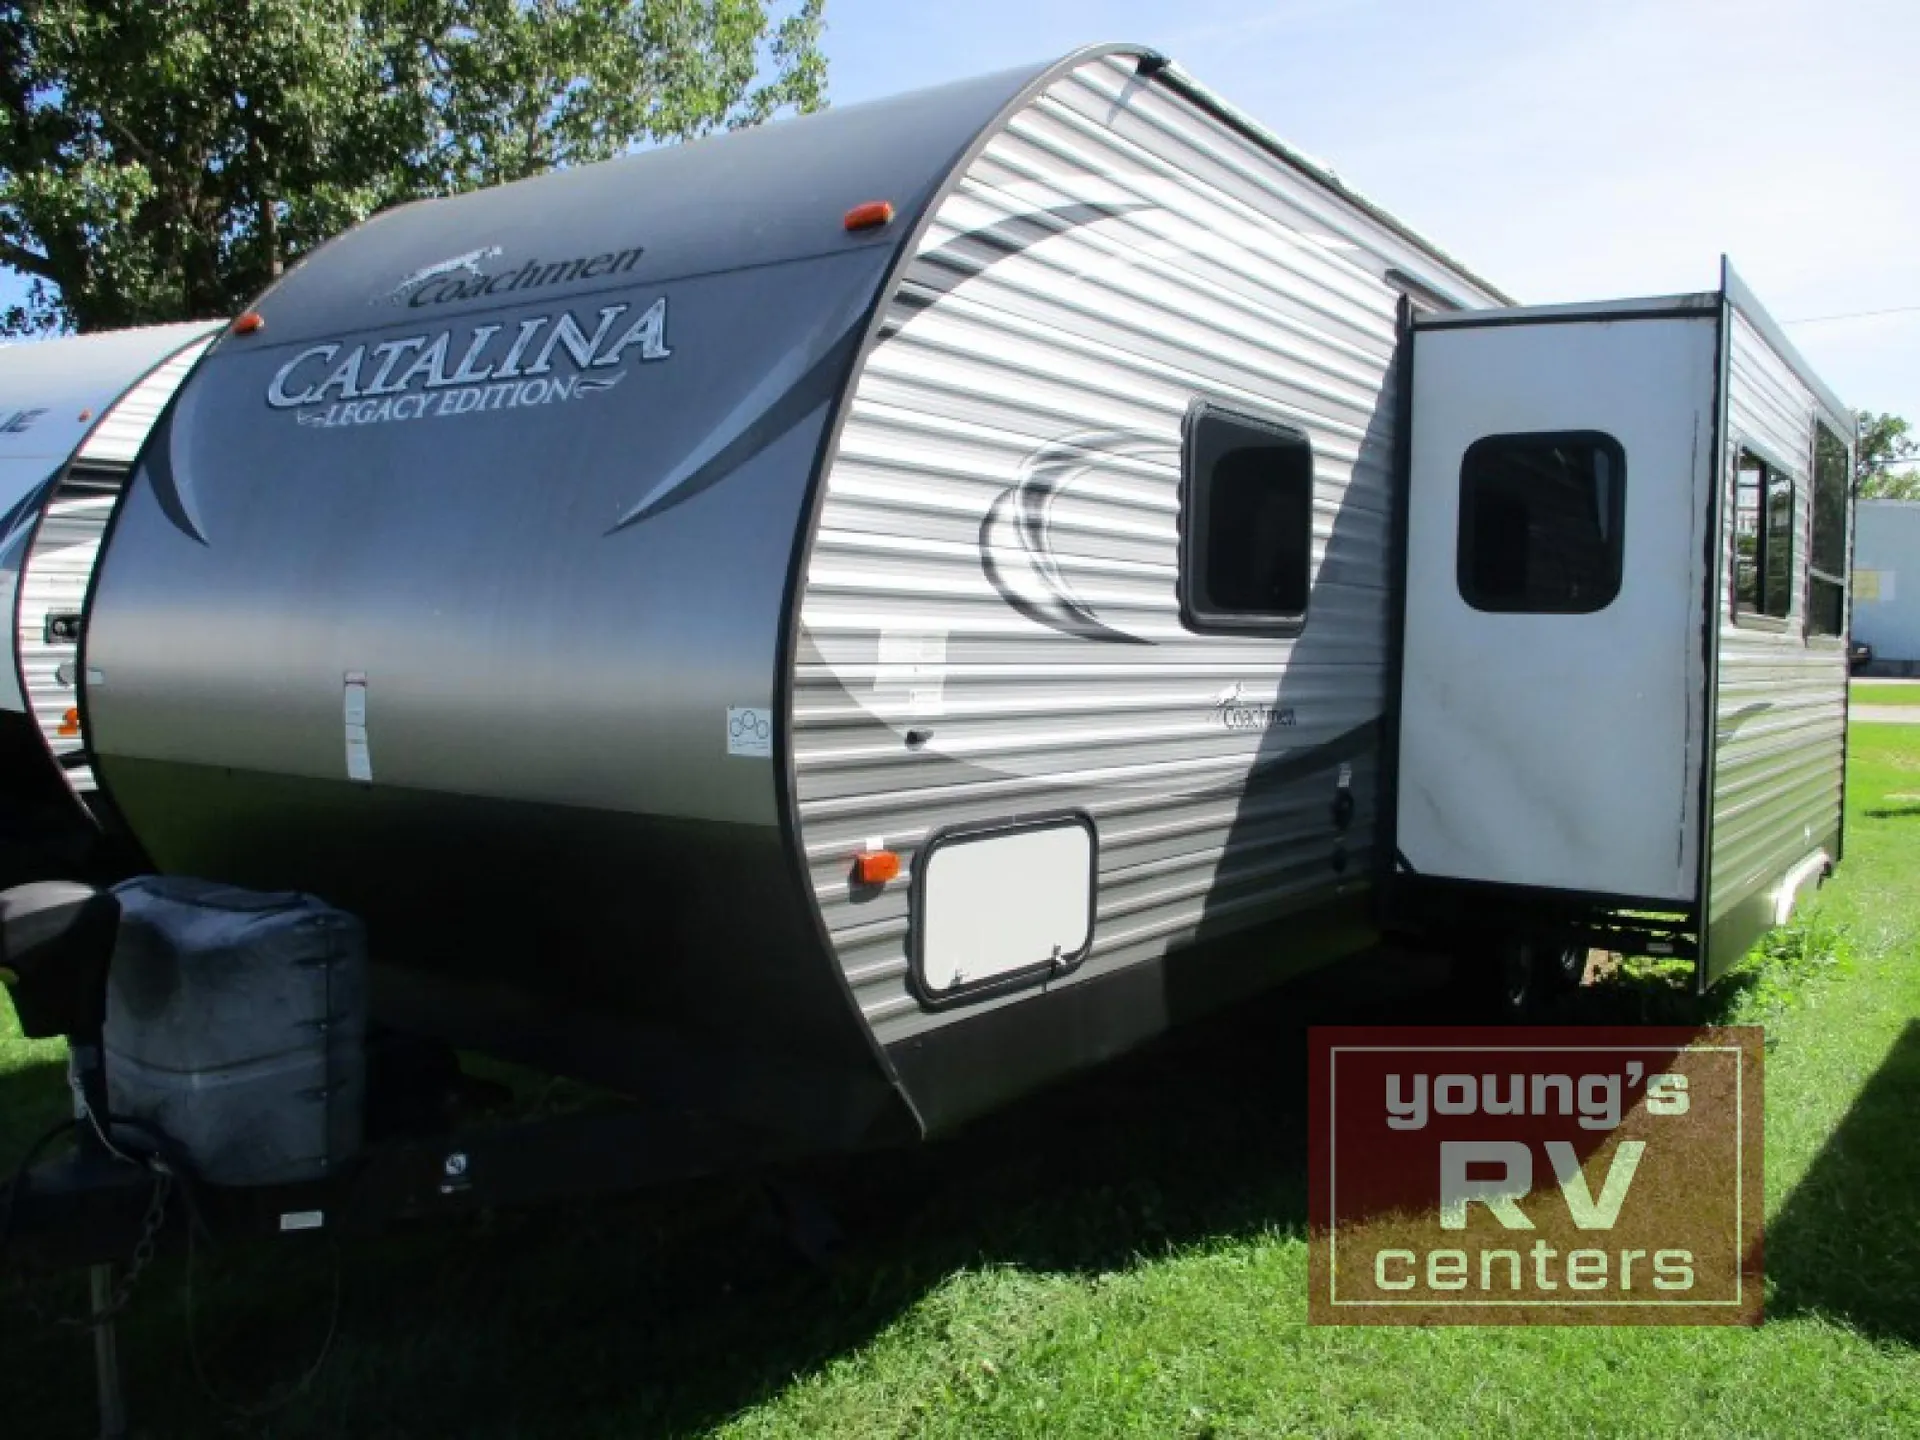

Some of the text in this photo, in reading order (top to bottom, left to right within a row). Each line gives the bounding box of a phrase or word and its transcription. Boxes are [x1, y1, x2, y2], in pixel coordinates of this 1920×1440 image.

[406, 246, 644, 308] Coachmen
[265, 295, 672, 409] CATALINA
[322, 375, 578, 429] LEGACY EDITION
[1223, 703, 1297, 730] Coachmen
